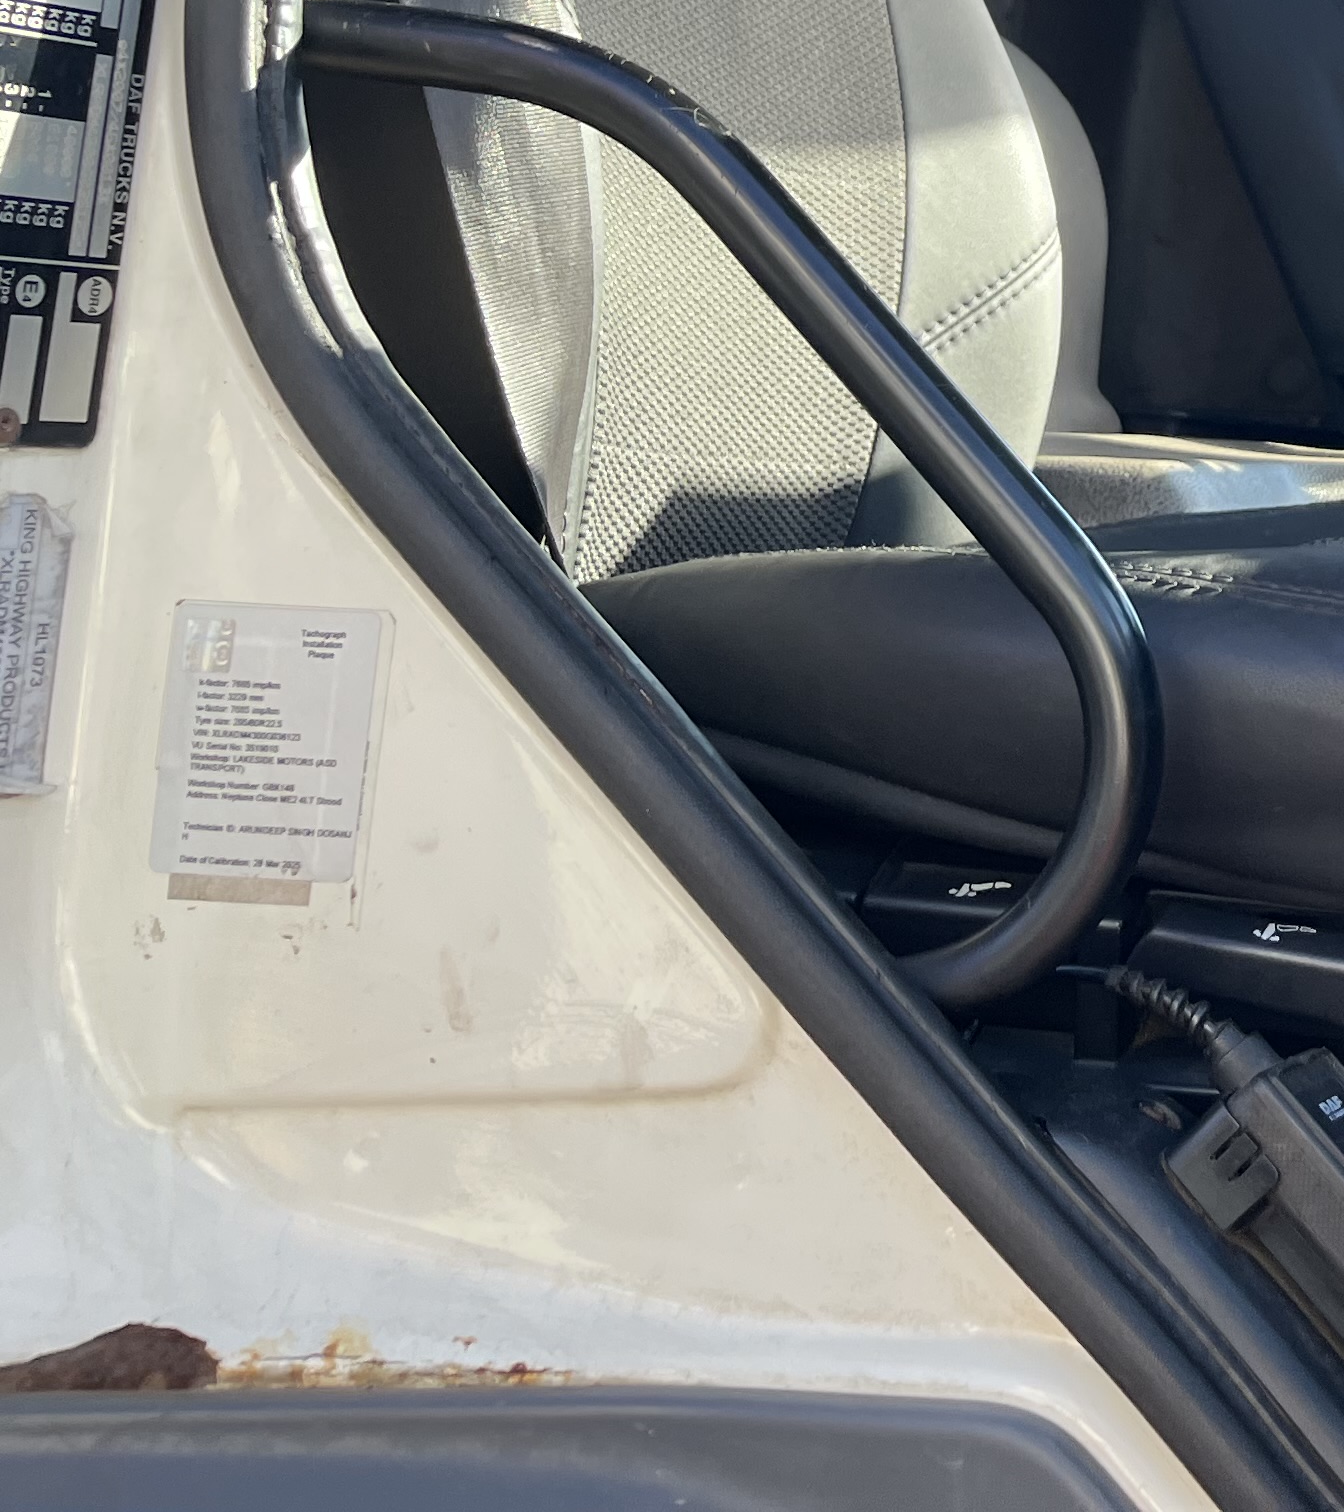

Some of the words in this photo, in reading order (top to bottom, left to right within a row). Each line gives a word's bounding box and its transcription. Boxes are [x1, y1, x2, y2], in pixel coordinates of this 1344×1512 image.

[11, 2, 31, 26] kg
[27, 5, 48, 29] kg
[44, 8, 64, 32] kg
[60, 11, 81, 34] kg
[77, 14, 97, 37] kg
[127, 73, 145, 115] DAF
[114, 121, 140, 204] TRUCKS
[0, 199, 19, 223] kg
[15, 201, 36, 225] kg
[32, 203, 53, 226] kg
[49, 205, 70, 228] kg
[108, 211, 127, 250] N.V.
[0, 268, 16, 304] Type
[20, 509, 38, 554] KING
[8, 560, 32, 649] HIGHWAY
[301, 628, 347, 639] Tachograph
[30, 622, 50, 688] HL1073
[307, 650, 335, 659] Plaque
[0, 654, 20, 759] PRODUCTS
[190, 762, 246, 775] TRANSPORT)
[232, 754, 275, 765] LAKESIDE
[276, 756, 314, 767] MOTORS
[187, 779, 226, 790] Workshop
[179, 854, 197, 864] Date
